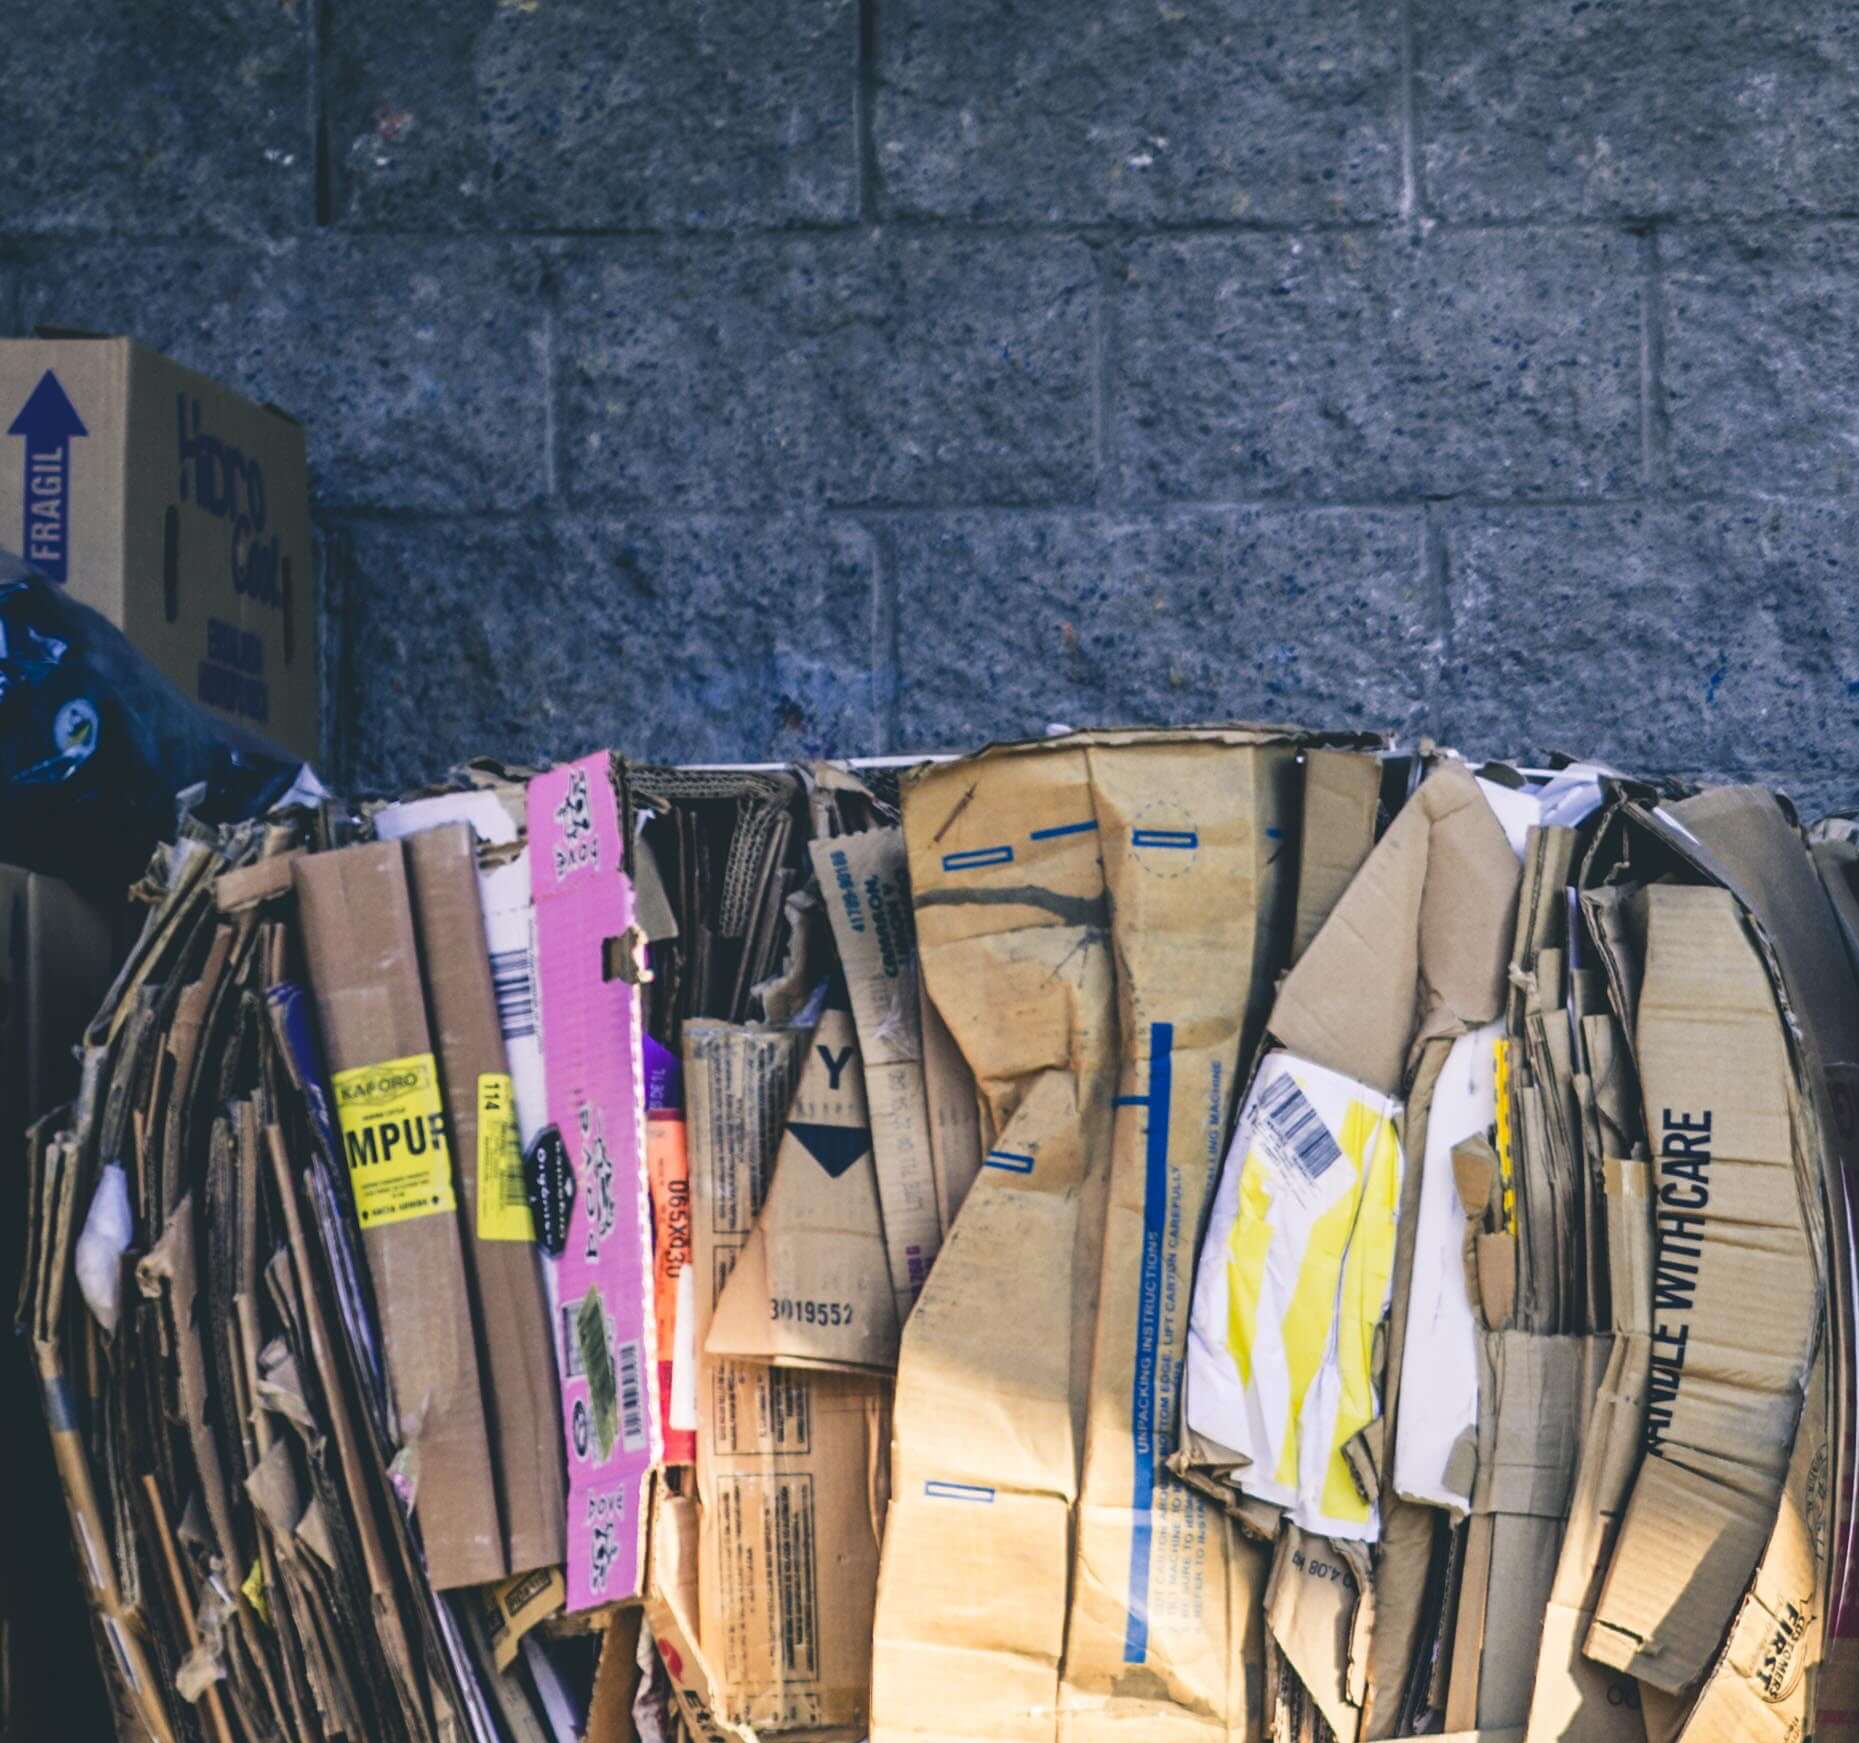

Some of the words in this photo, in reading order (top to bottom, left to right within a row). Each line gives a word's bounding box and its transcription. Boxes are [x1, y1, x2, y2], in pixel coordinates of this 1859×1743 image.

[31, 447, 63, 561] FRAGIL
[1208, 1060, 1223, 1122] MACHINE
[1657, 1107, 1712, 1211] CARE
[1168, 1166, 1181, 1254] CAREFULLY
[1141, 1230, 1159, 1353] INSTRUCTIONS
[1164, 1255, 1177, 1311] CARTON
[1655, 1210, 1707, 1310] WITH
[770, 1297, 853, 1326] 3019552
[1162, 1314, 1175, 1346] LIFT
[1137, 1357, 1153, 1455] UNPACKING
[1756, 1601, 1800, 1691] FIRST
[1769, 1616, 1805, 1700] CUSTOMERS
